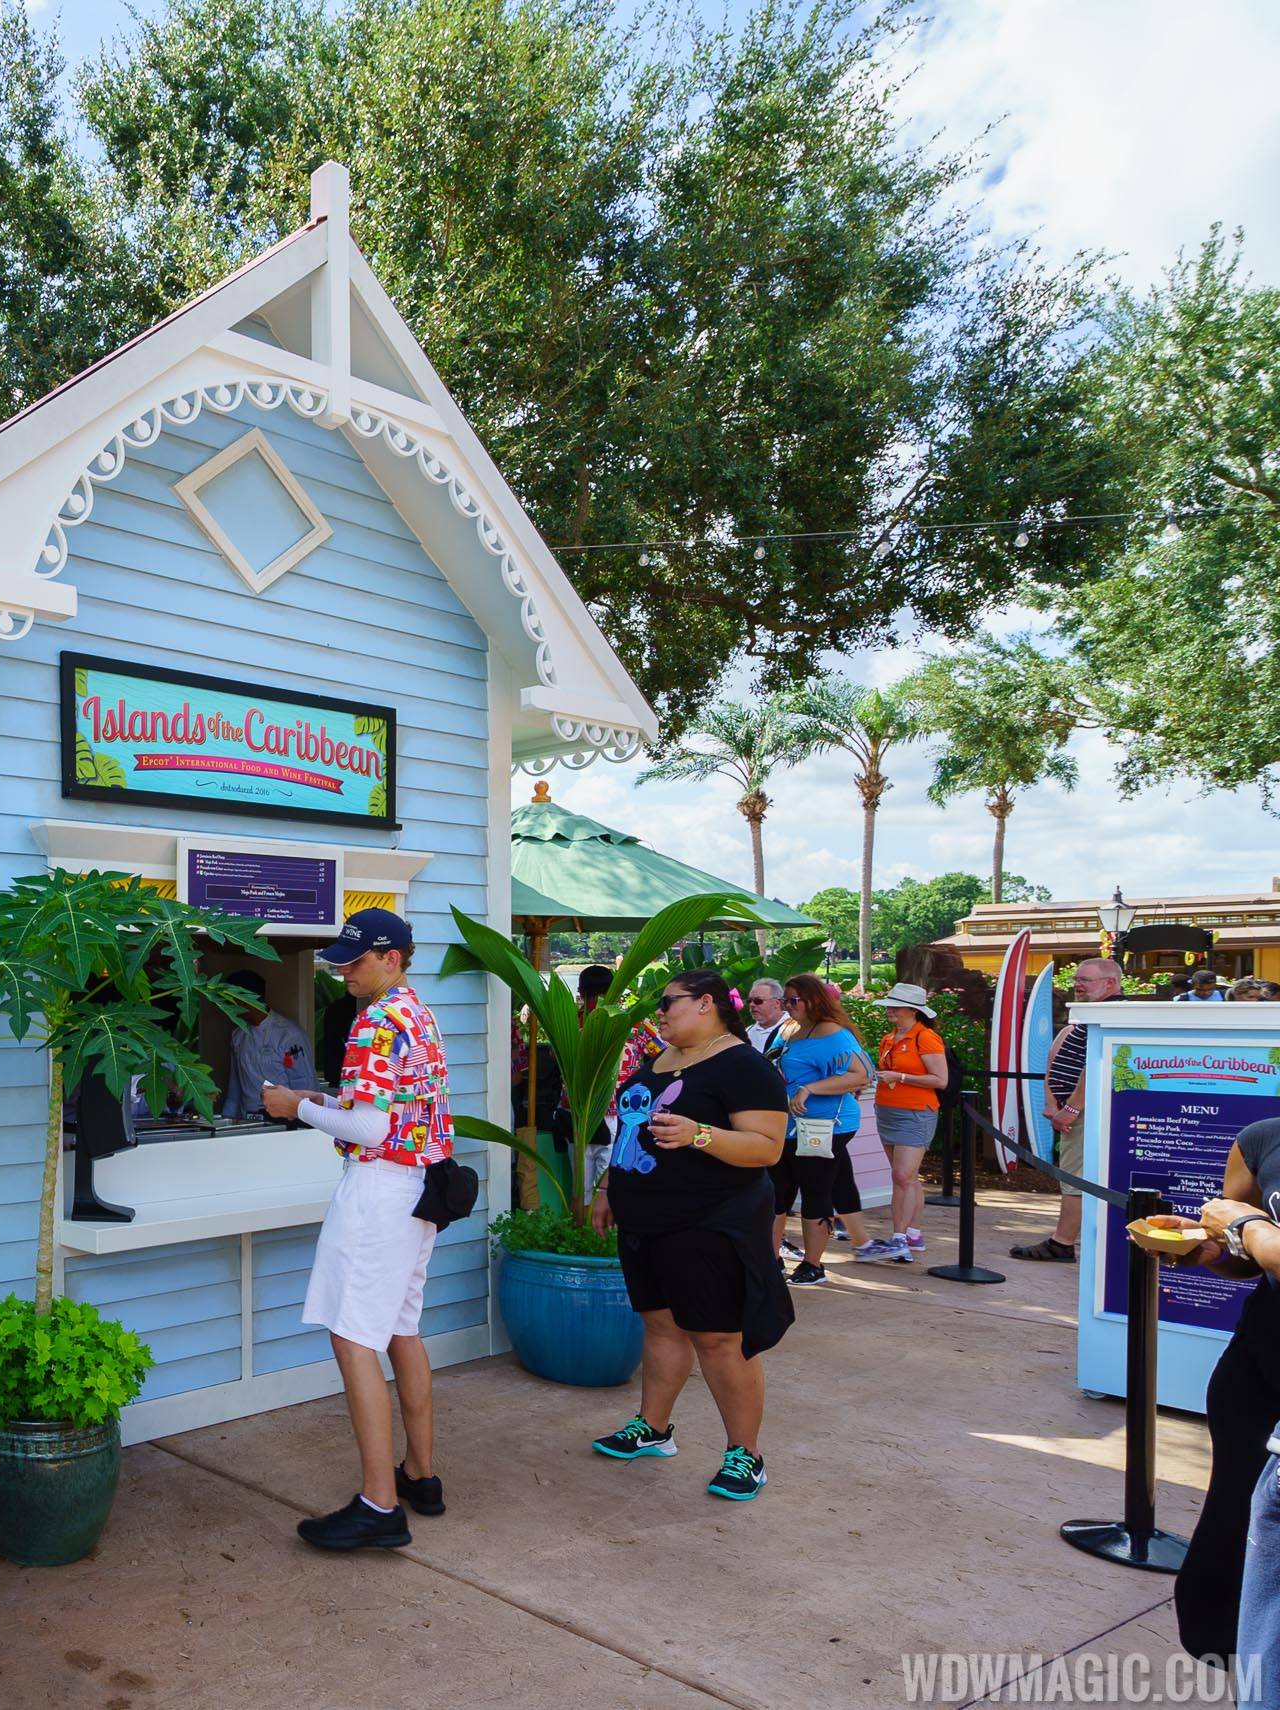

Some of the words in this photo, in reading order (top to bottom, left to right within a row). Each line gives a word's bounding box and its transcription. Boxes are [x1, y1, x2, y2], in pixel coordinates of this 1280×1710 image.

[82, 696, 206, 745] Islands
[207, 711, 223, 739] of
[222, 720, 243, 742] the
[244, 707, 382, 780] Caribbean
[220, 783, 253, 795] Introduced
[255, 786, 270, 796] 2016
[1133, 1056, 1185, 1070] Islands
[1202, 1054, 1277, 1075] Caribbean
[1181, 1104, 1219, 1115] MENU
[1136, 1115, 1166, 1123] Jamaican
[1167, 1116, 1182, 1124] Beef
[1148, 1124, 1165, 1132] Mojo
[1136, 1136, 1161, 1144] Pescado
[1180, 1179, 1198, 1187] Mojo
[1182, 1185, 1204, 1193] Frozen
